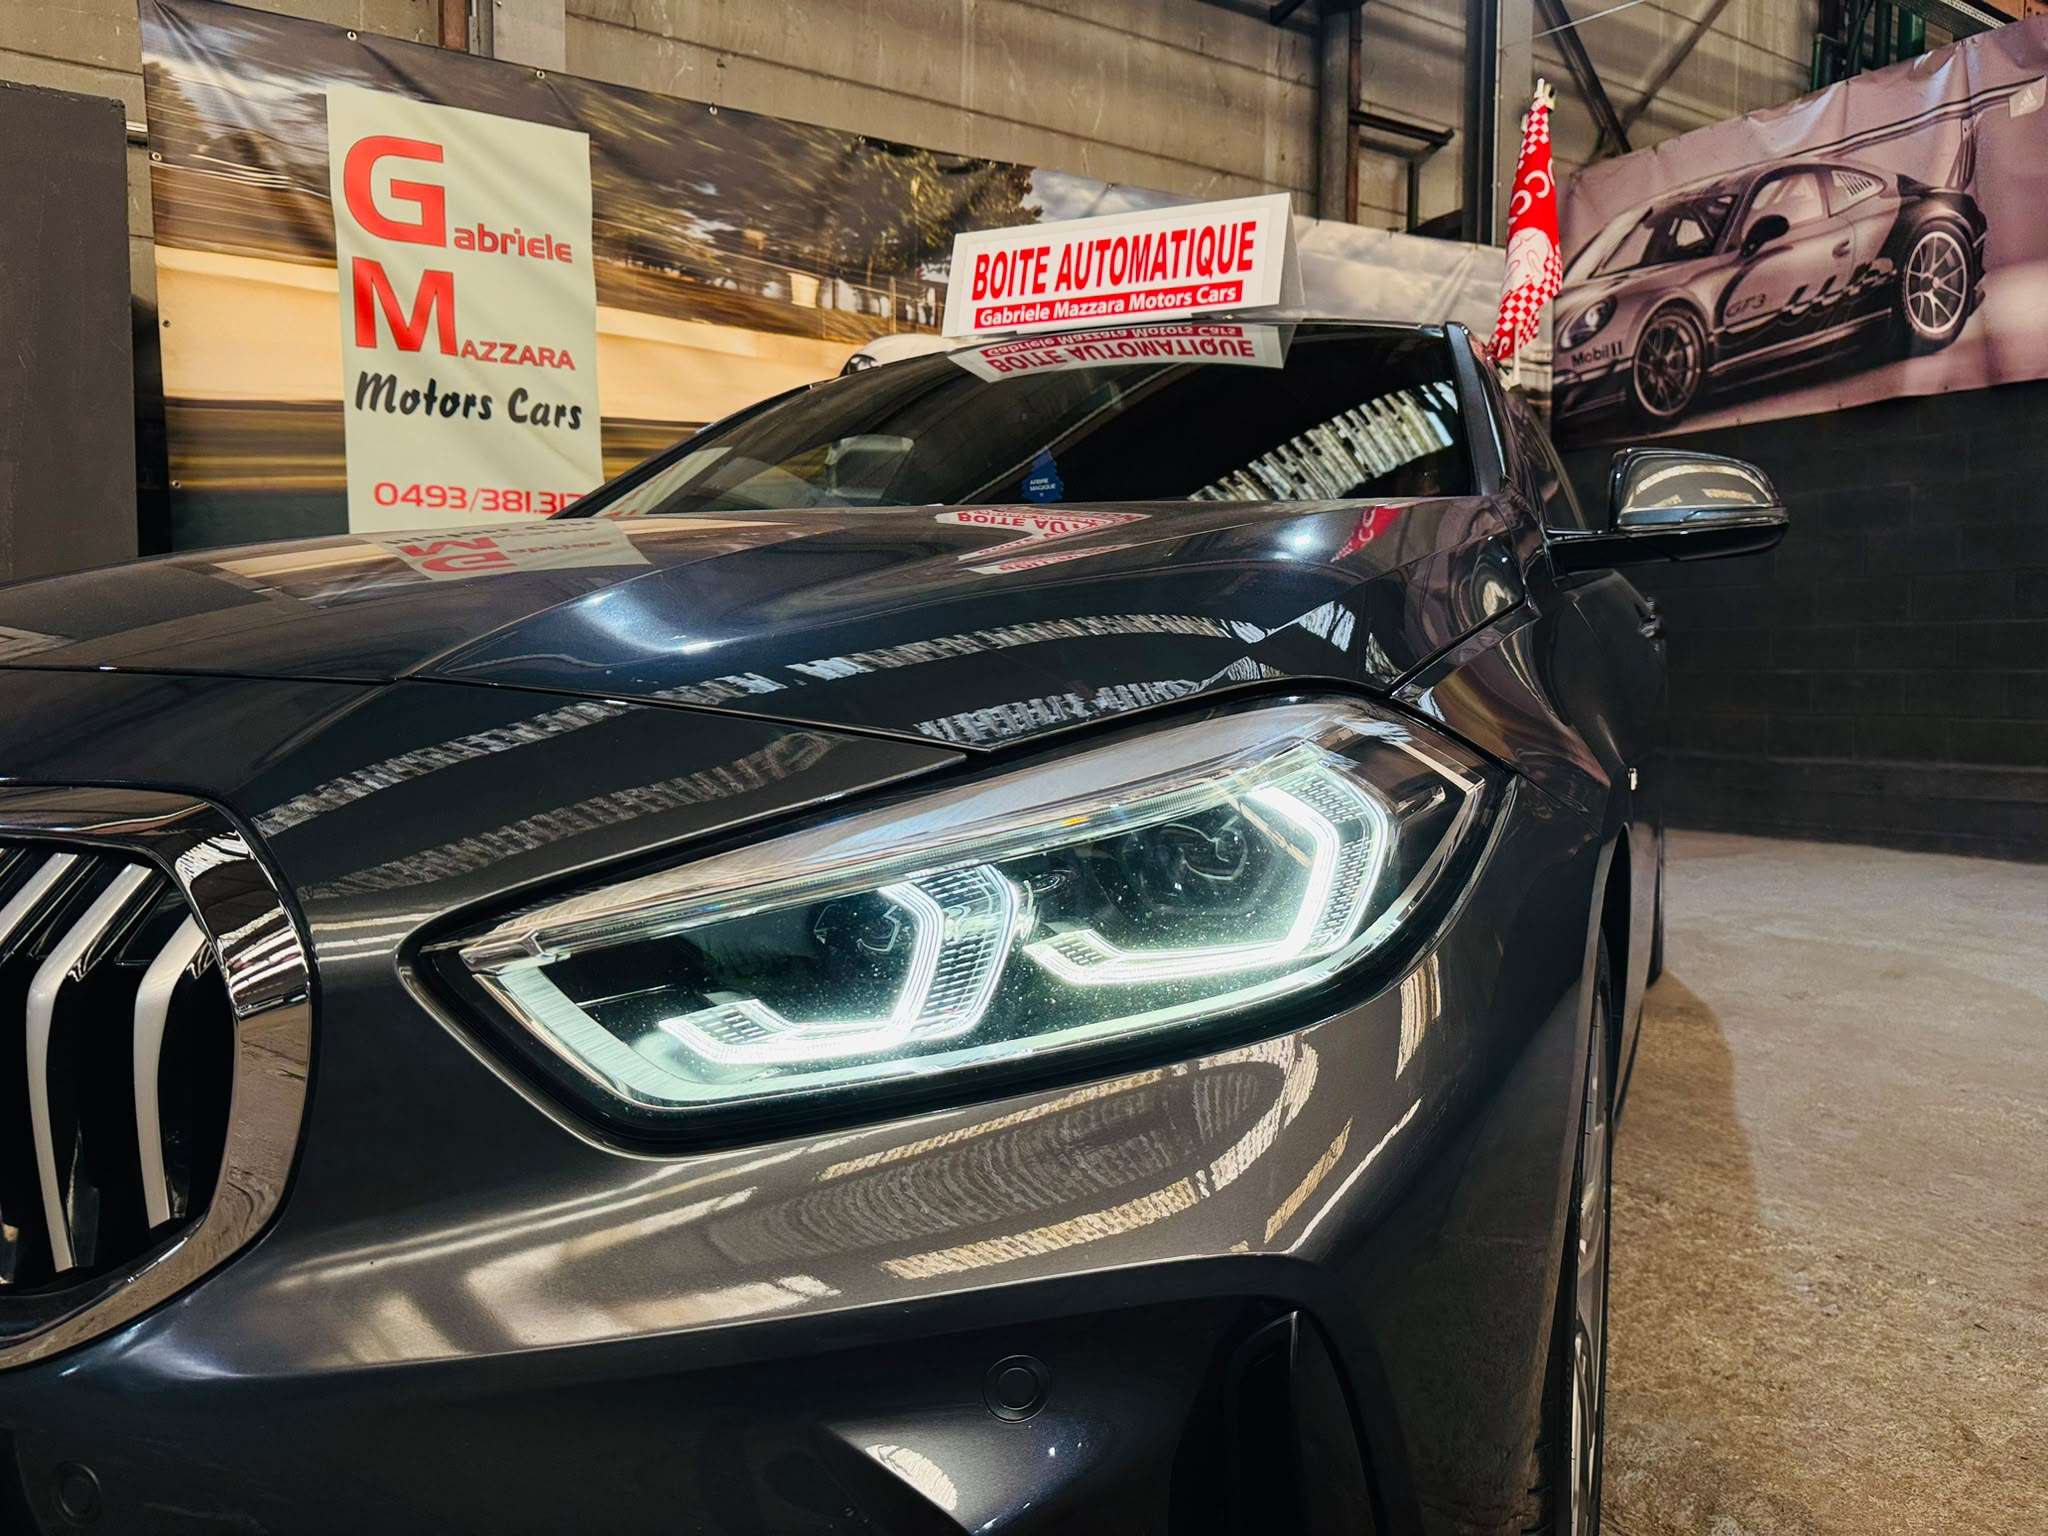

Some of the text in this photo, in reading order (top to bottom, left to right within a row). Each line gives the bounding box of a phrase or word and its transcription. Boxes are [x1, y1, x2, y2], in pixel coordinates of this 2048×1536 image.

[343, 135, 573, 264] Gabriele
[972, 221, 1257, 300] BOITE AUTOMATIQUE
[352, 256, 576, 371] MAZZARA
[979, 284, 1237, 326] Gabriele Mazzara Motors Cars
[1571, 343, 1609, 368] Mobil
[355, 371, 582, 430] Motors Cars
